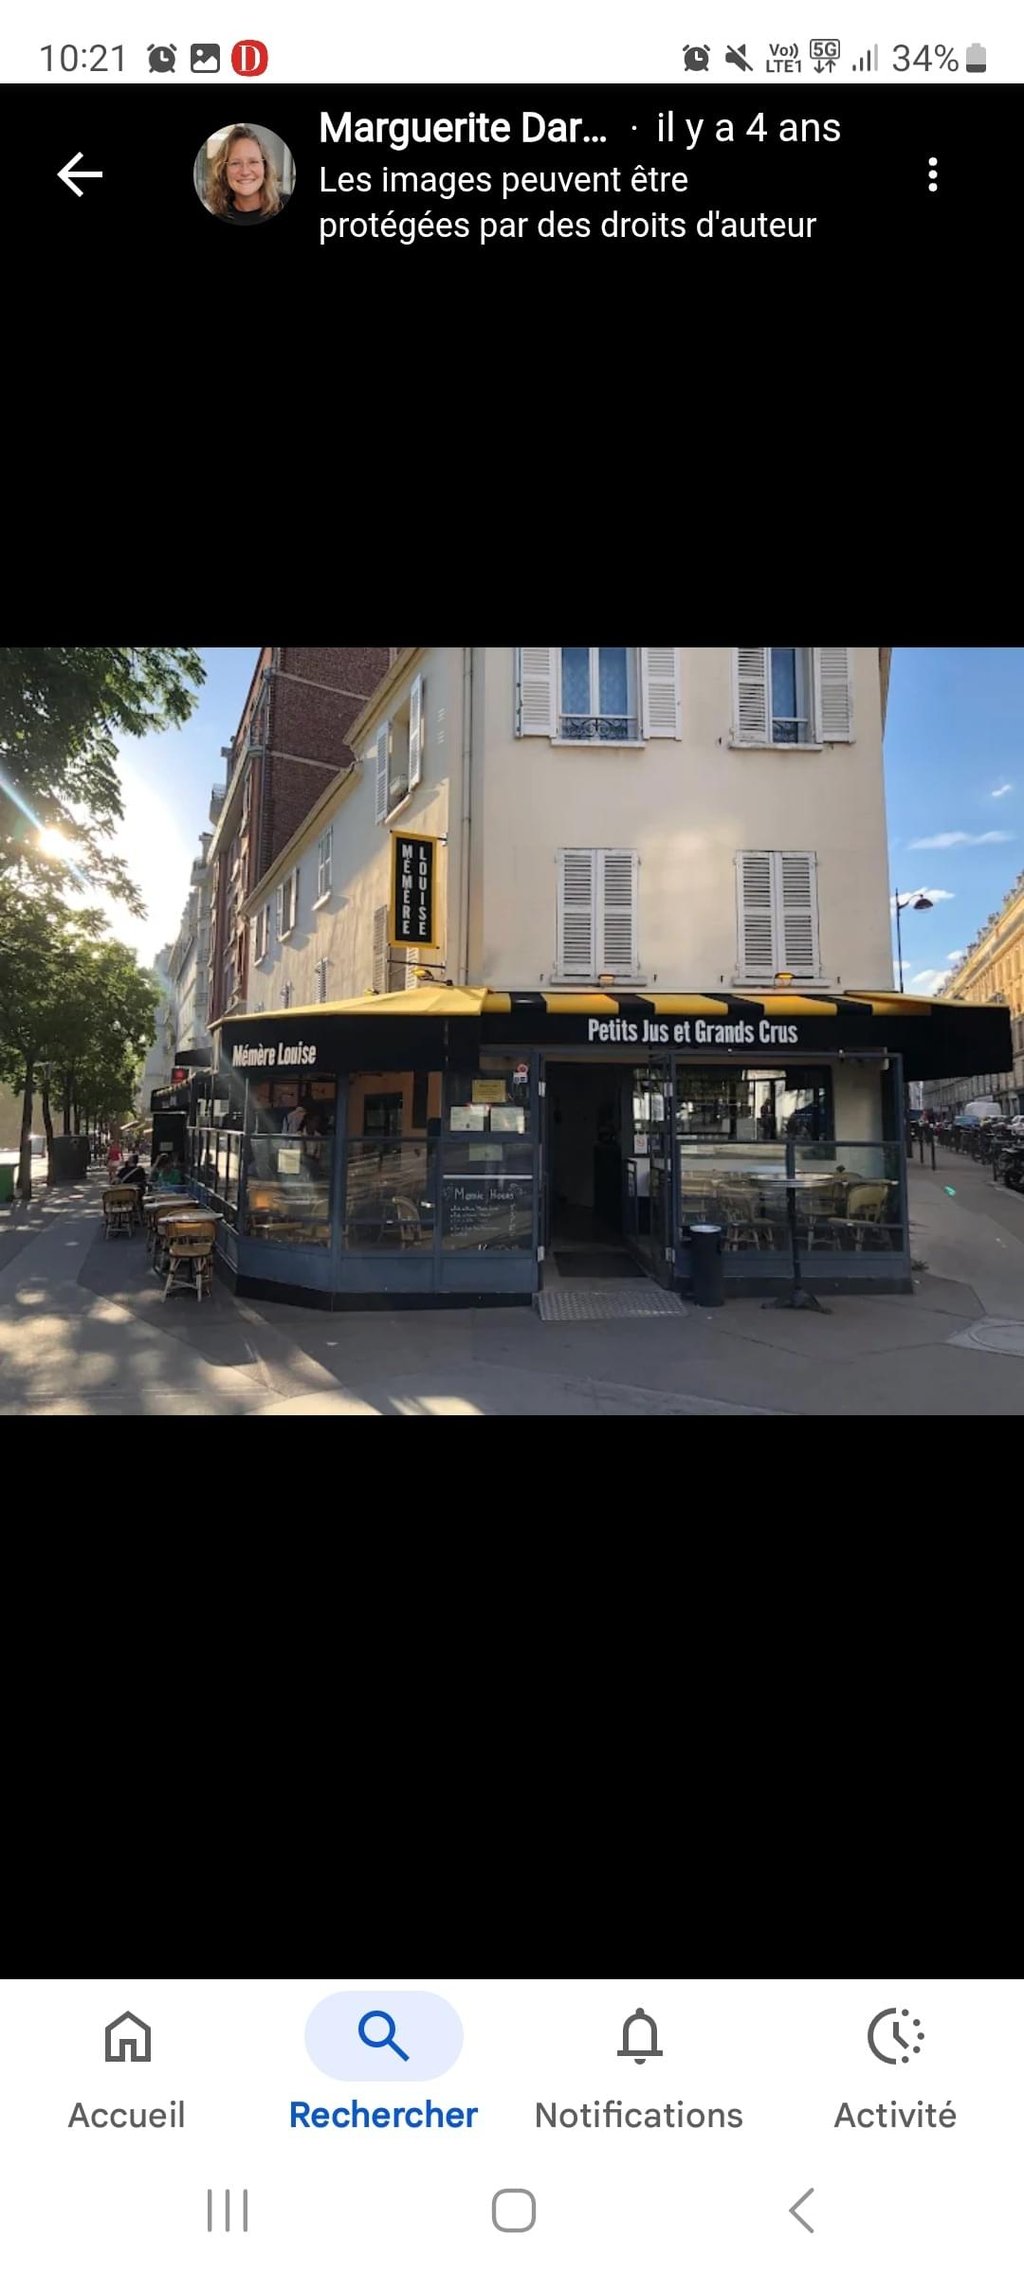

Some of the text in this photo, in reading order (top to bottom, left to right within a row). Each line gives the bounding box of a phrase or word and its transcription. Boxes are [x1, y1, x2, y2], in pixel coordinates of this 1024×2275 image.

[419, 846, 428, 936] LOUISE
[588, 1018, 798, 1043] Petits Jus et Grands Crus
[232, 1041, 316, 1067] Mémère Louise
